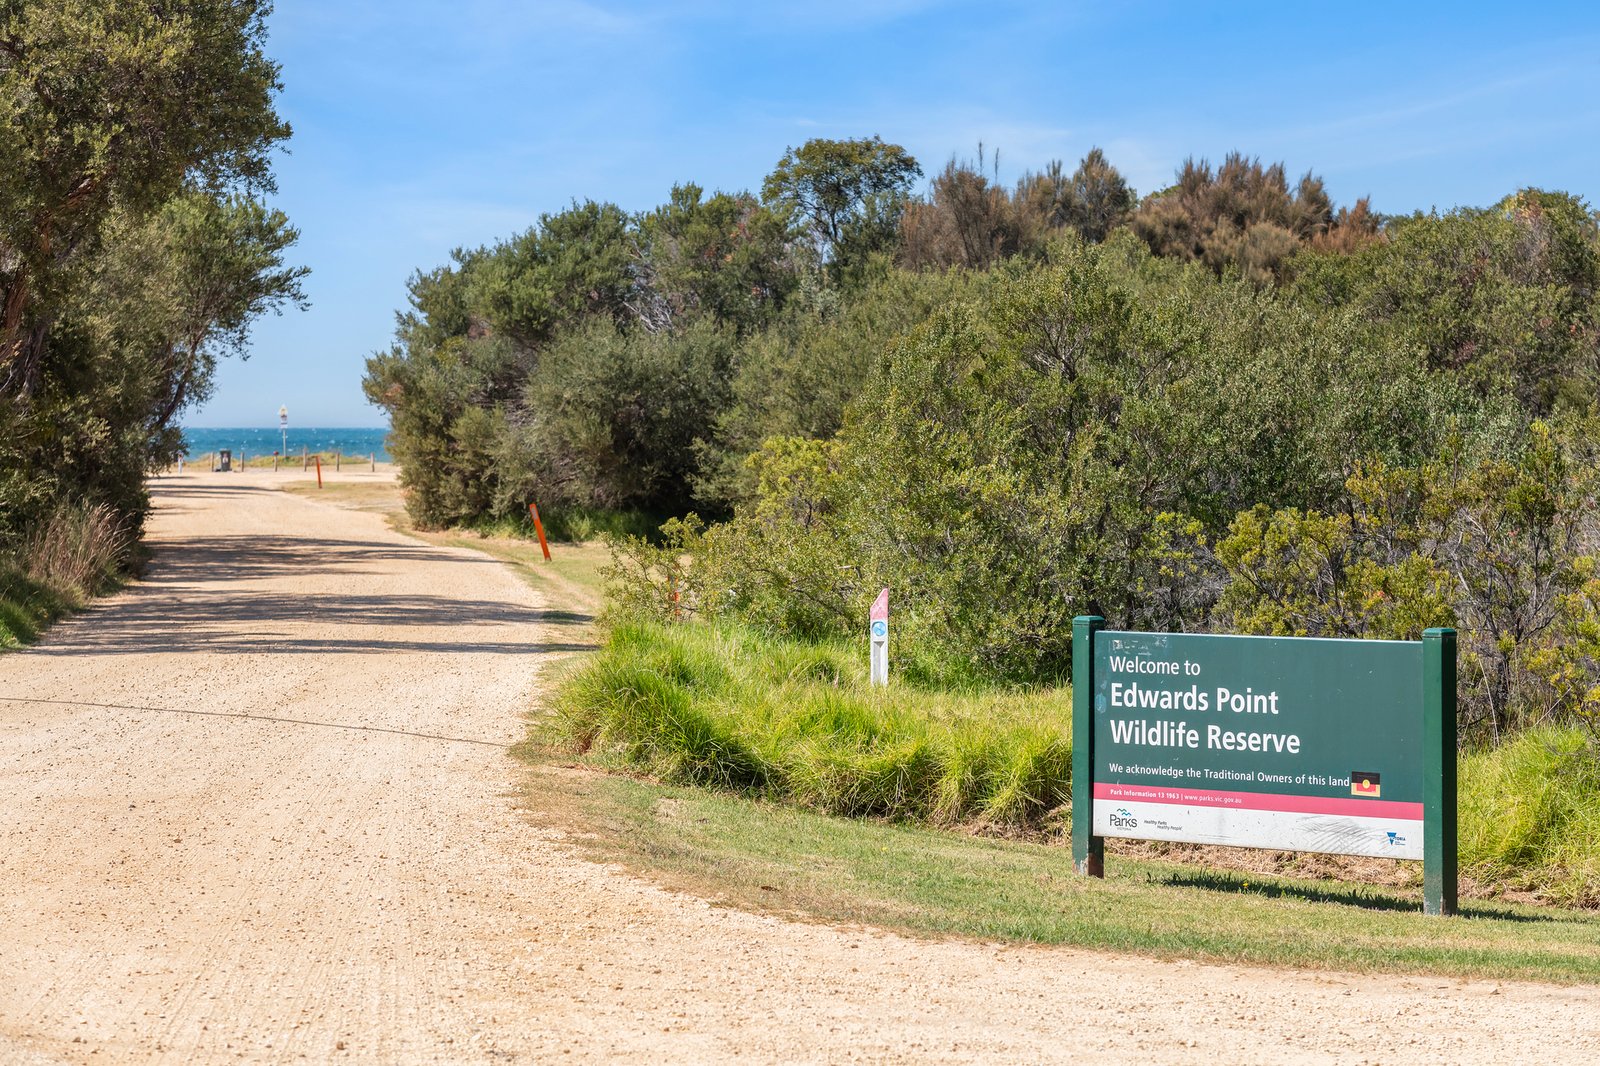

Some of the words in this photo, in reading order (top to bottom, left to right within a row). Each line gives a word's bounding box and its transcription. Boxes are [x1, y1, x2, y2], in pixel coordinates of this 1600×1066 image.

[1110, 656, 1180, 675] Welcome
[1184, 660, 1200, 676] to
[1111, 682, 1208, 711] Edwards
[1216, 687, 1279, 714] Point
[1110, 720, 1199, 748] Wildlife
[1208, 724, 1300, 754] Reserve
[1109, 763, 1123, 773] We
[1126, 764, 1184, 778] acknowledge
[1186, 768, 1201, 778] the
[1204, 768, 1254, 781] Traditional
[1258, 772, 1292, 784] Owners
[1296, 774, 1306, 784] of
[1308, 774, 1326, 786] this
[1328, 775, 1350, 787] land
[1124, 790, 1156, 798] Information
[1110, 814, 1138, 828] Parks
